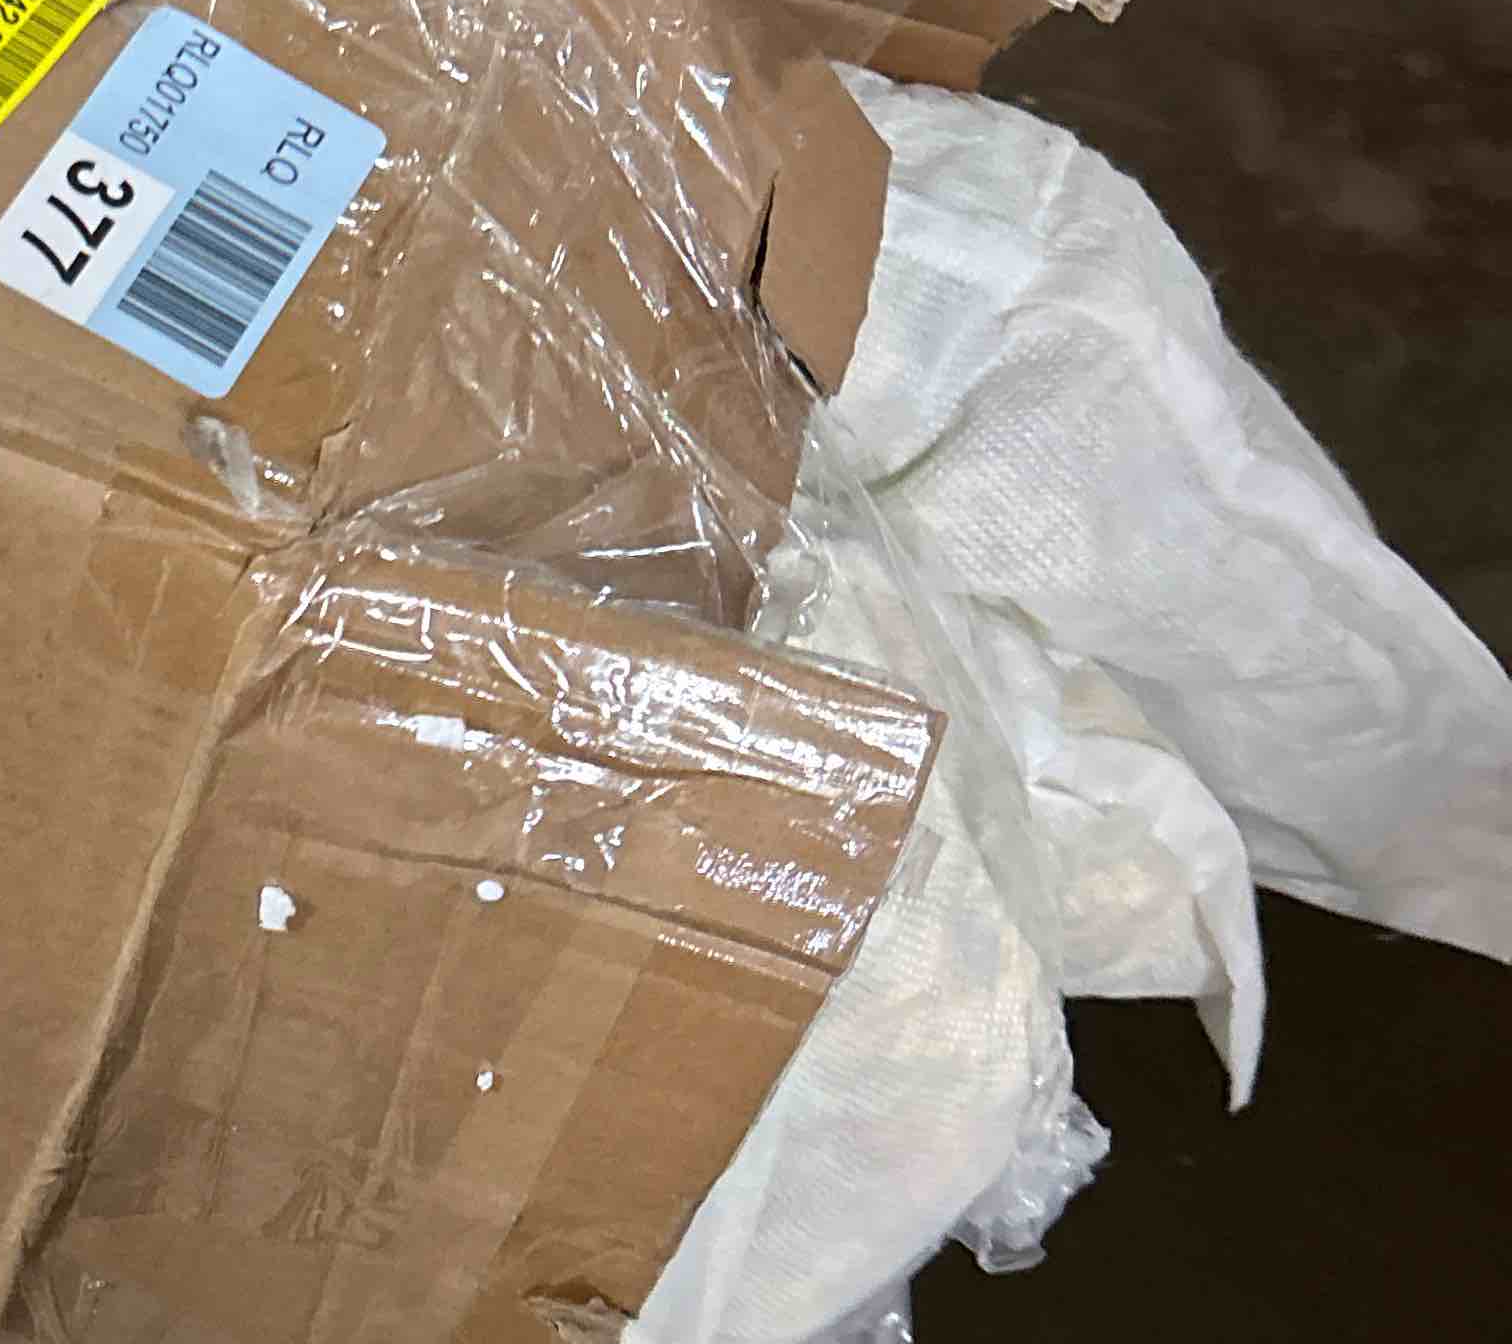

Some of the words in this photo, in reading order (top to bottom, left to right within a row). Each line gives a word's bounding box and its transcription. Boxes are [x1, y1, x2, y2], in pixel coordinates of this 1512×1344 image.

[118, 28, 221, 156] RLQ01750
[260, 115, 325, 186] RLQ
[22, 160, 136, 287] 377
